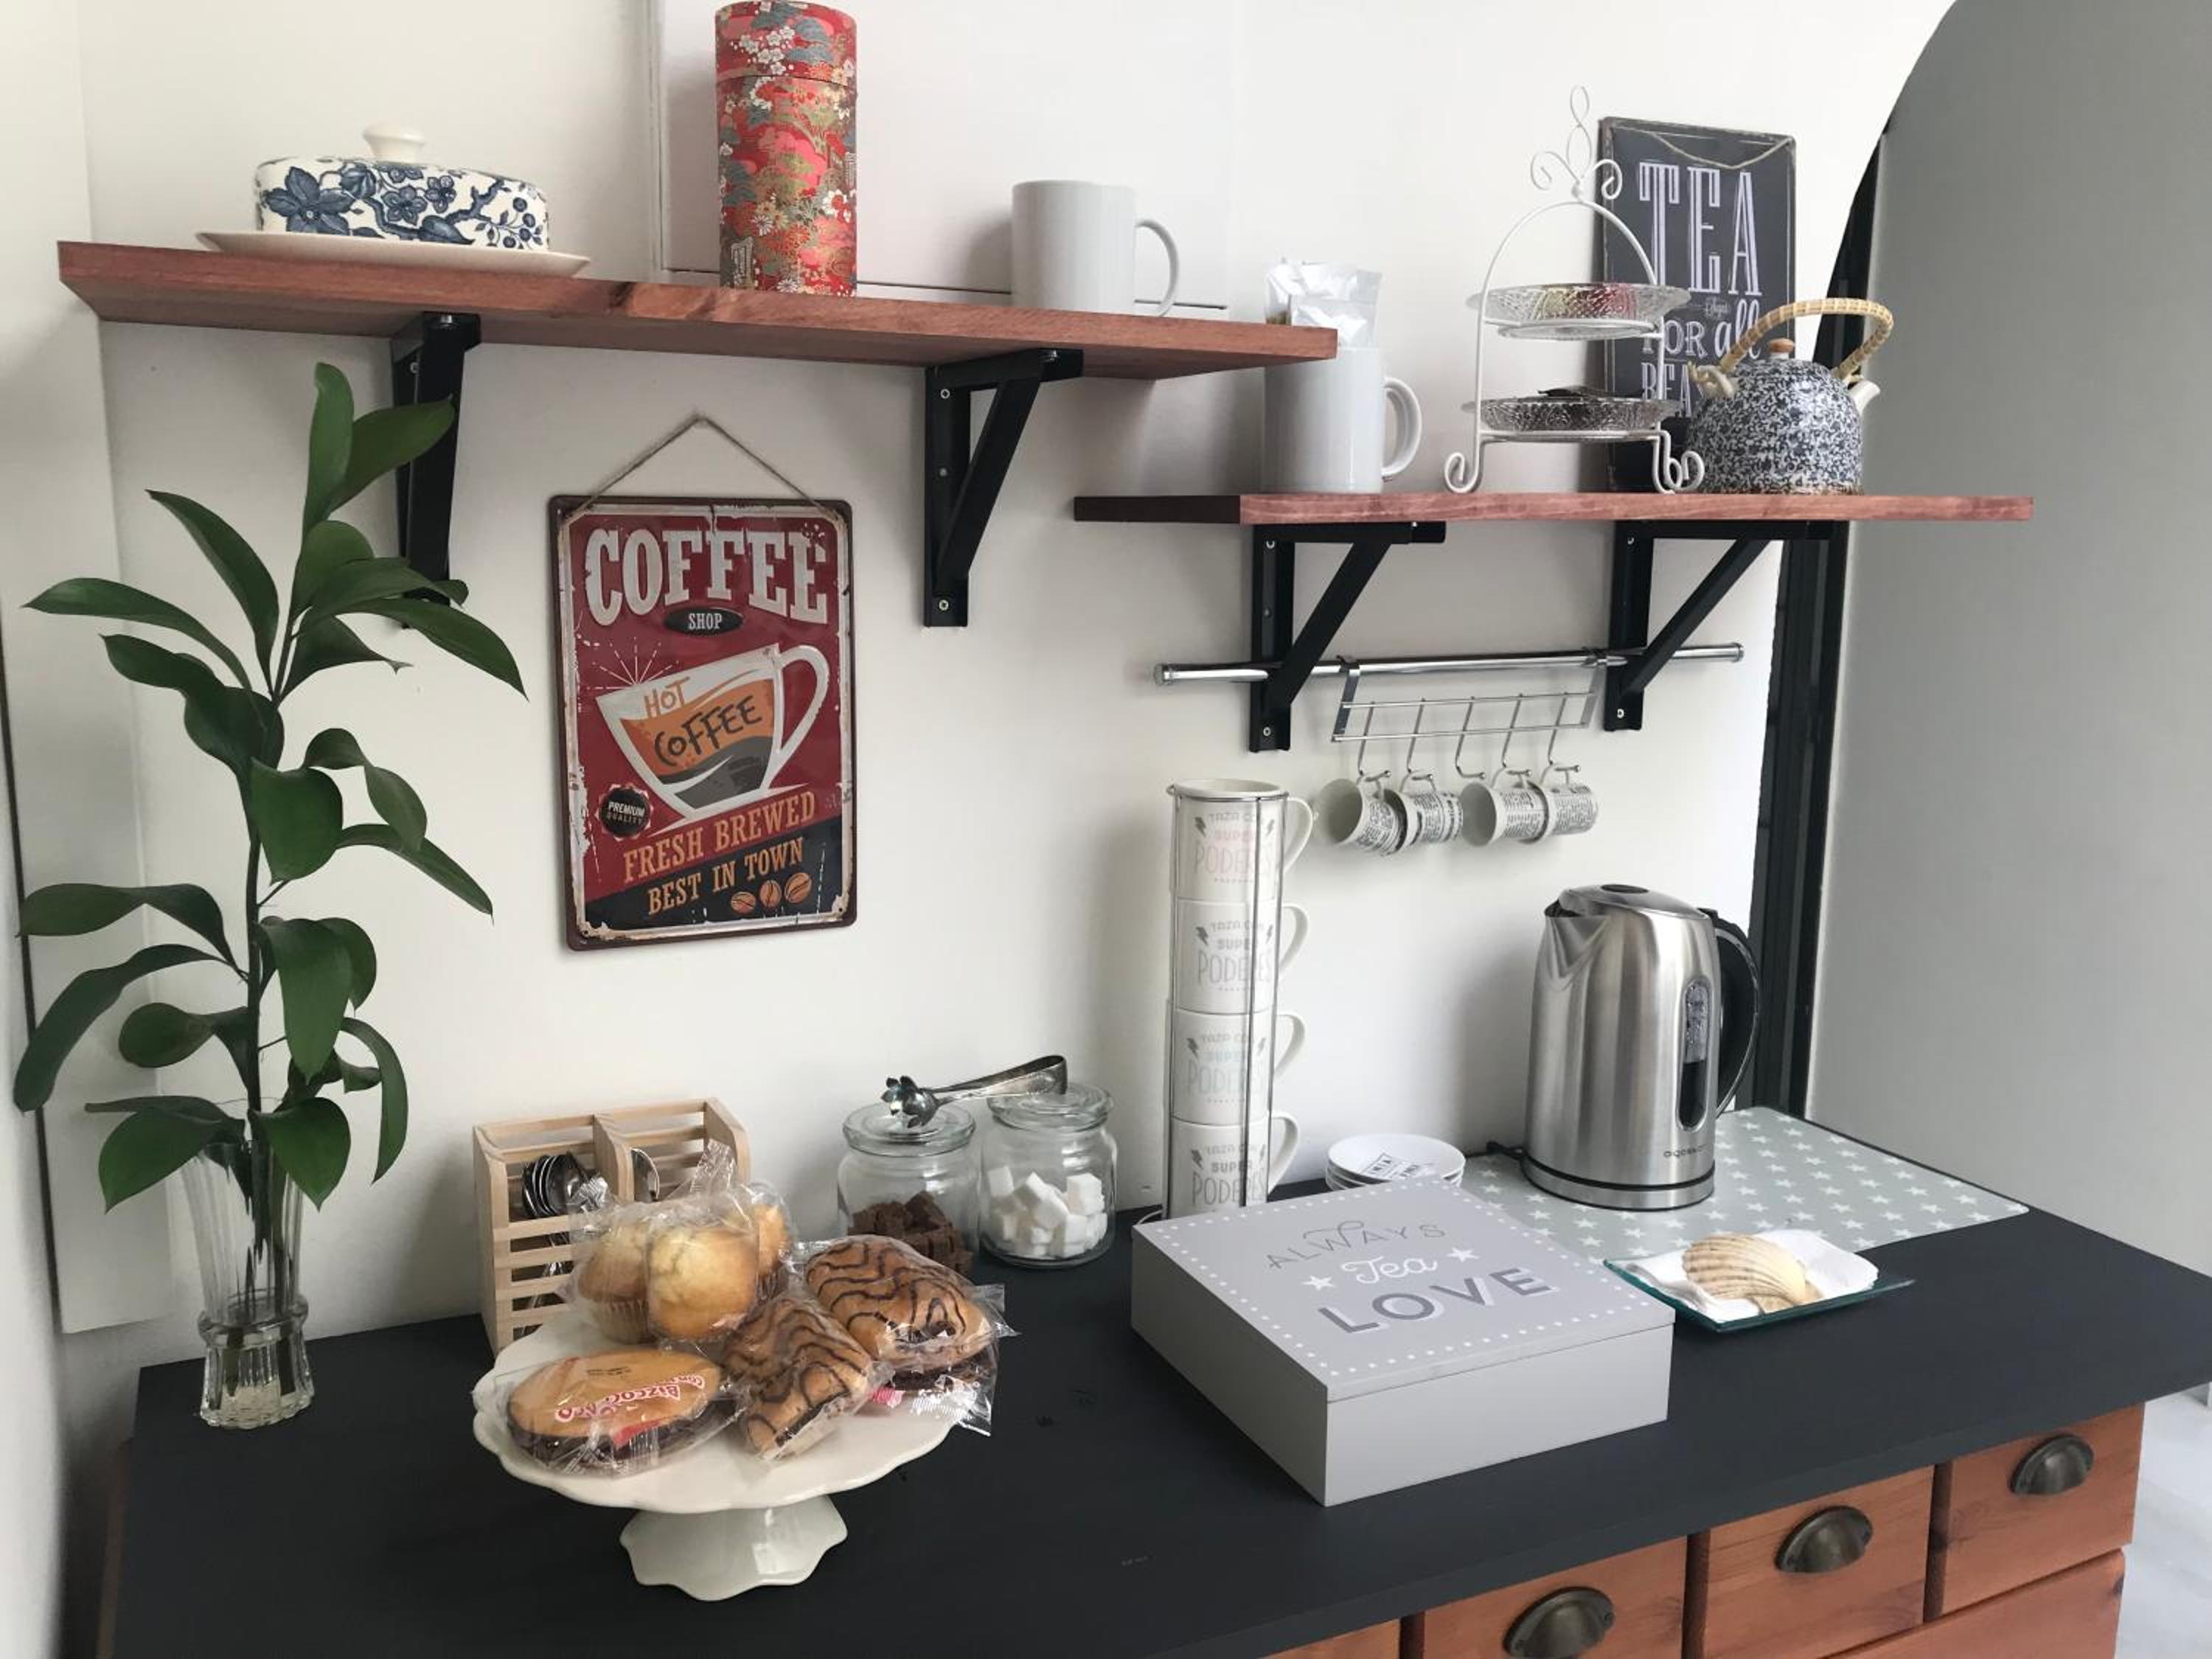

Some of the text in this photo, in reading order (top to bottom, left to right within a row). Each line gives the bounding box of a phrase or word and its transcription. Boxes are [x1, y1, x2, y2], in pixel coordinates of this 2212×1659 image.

[1639, 161, 1761, 296] TEA
[585, 527, 828, 627] COFFEE
[688, 612, 723, 631] SHOP
[644, 675, 690, 718] HOT
[608, 801, 645, 818] PREMIUM
[623, 792, 815, 883] FRESH BREWED
[647, 838, 804, 915] BEST IN TOWN
[1266, 1220, 1446, 1269] ALWAYS
[1340, 1255, 1438, 1284] Tea
[1318, 1267, 1559, 1334] LOVE
